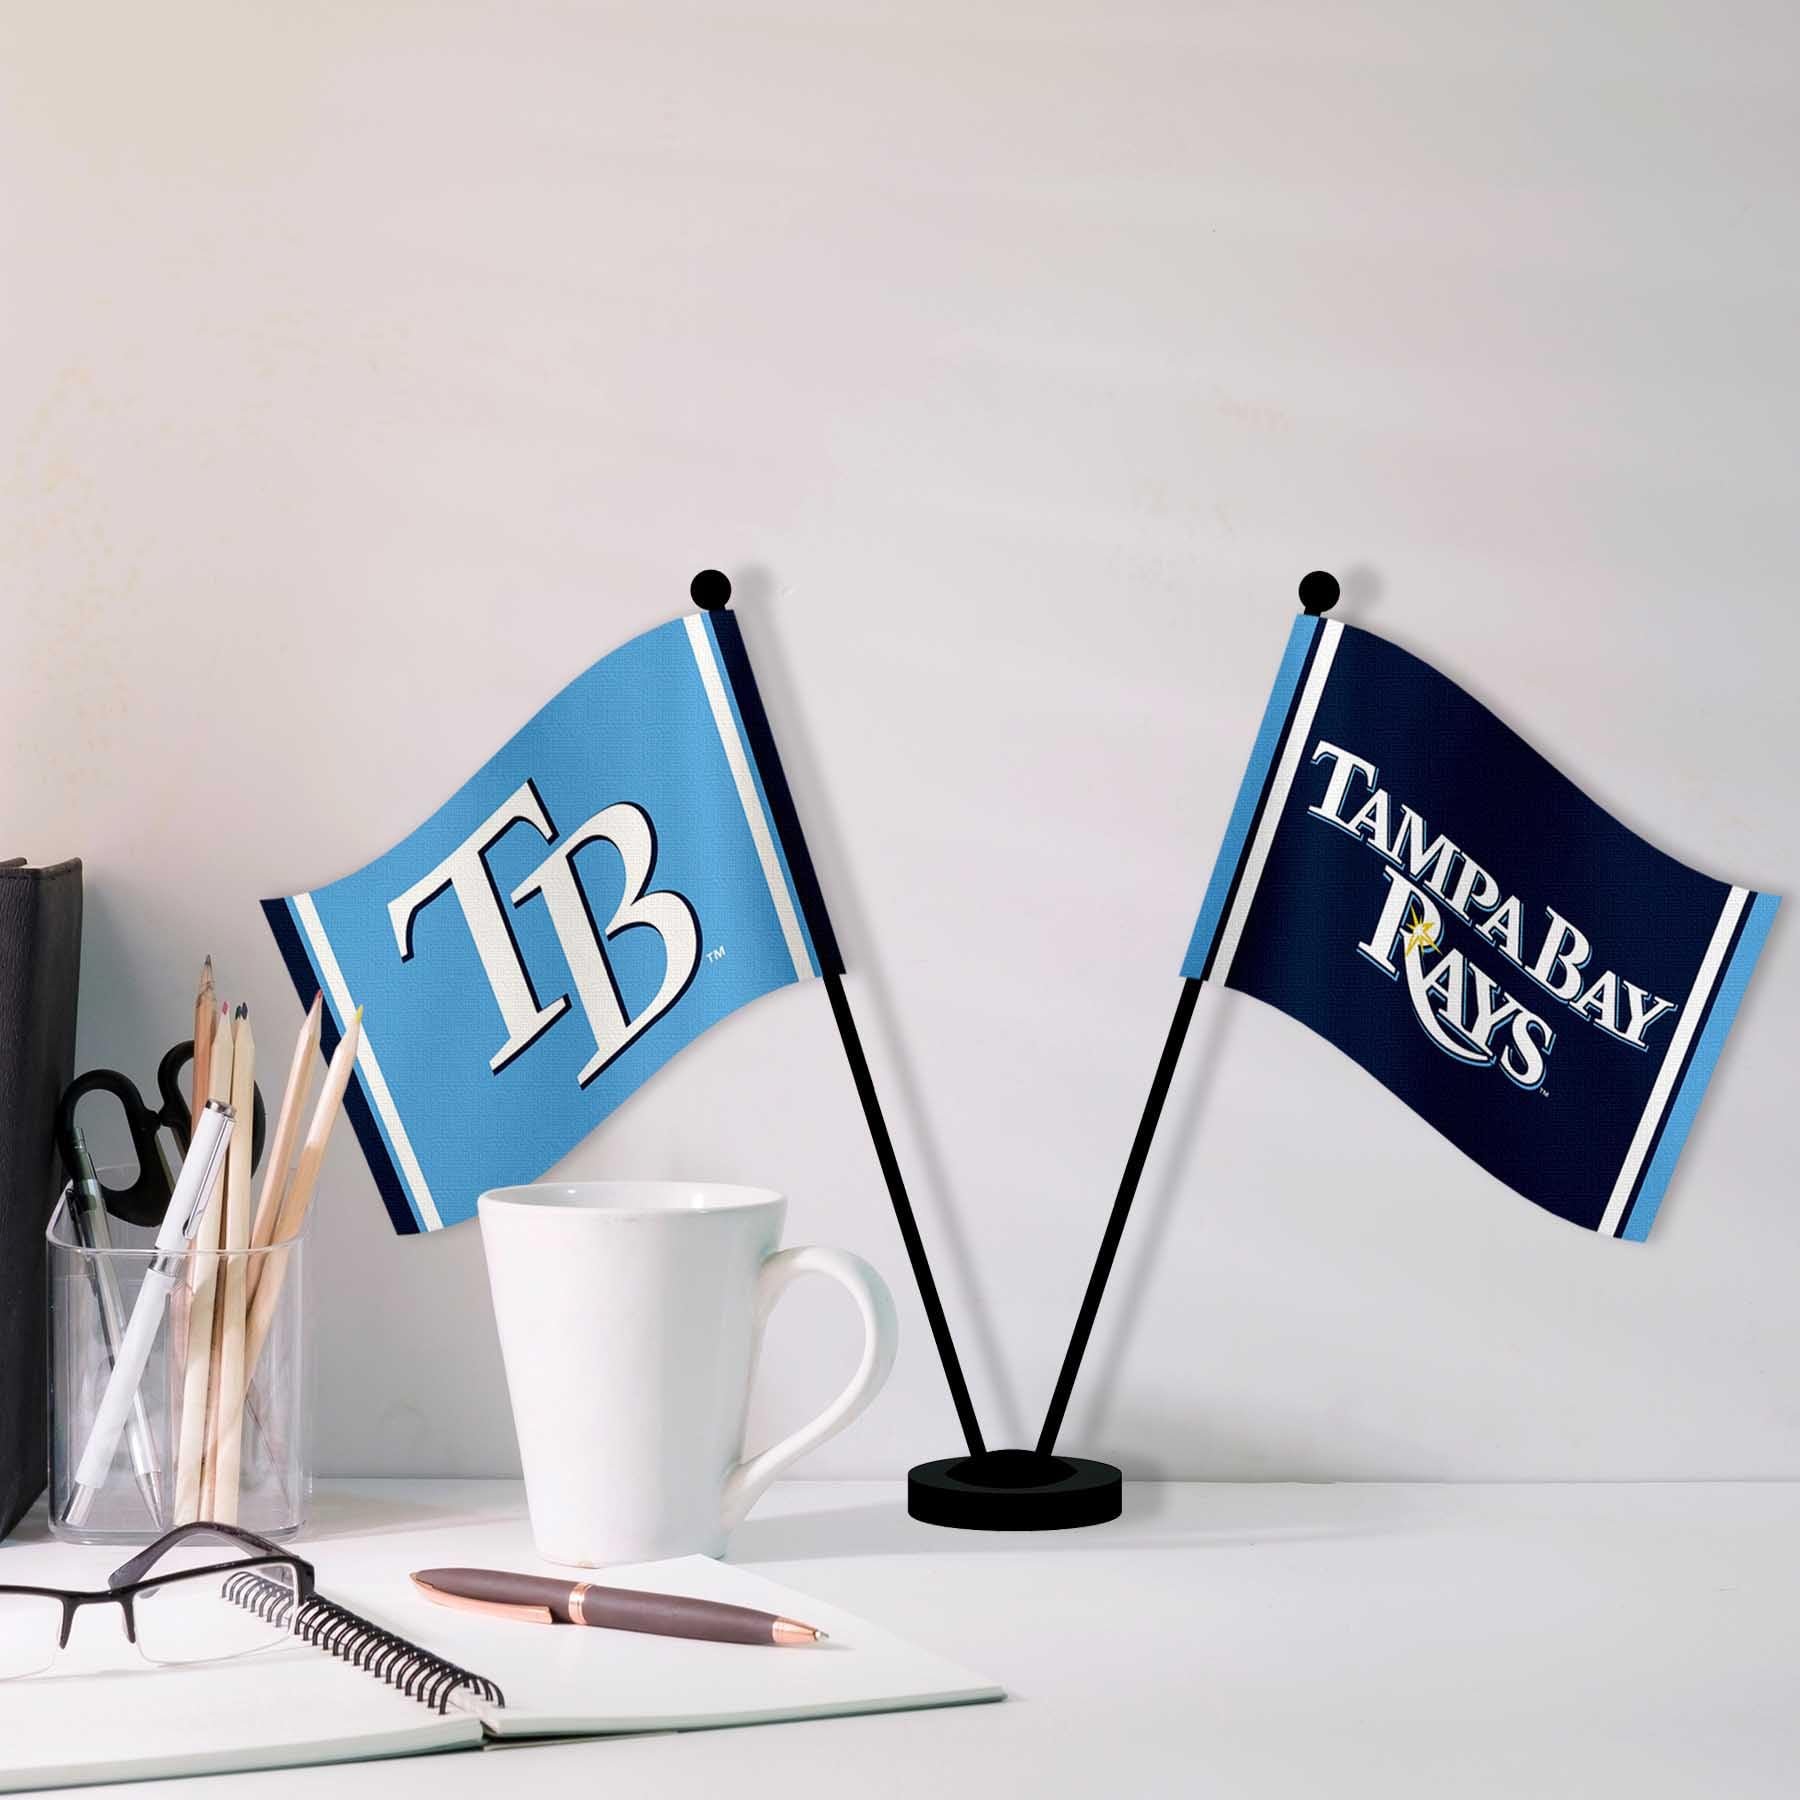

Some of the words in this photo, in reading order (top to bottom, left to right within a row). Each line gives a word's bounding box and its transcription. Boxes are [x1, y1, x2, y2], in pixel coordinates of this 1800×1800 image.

[387, 777, 704, 1091] TB
[1307, 740, 1527, 967] TAMPA
[1522, 905, 1678, 1052] BAY
[1356, 864, 1557, 1091] RAYS
